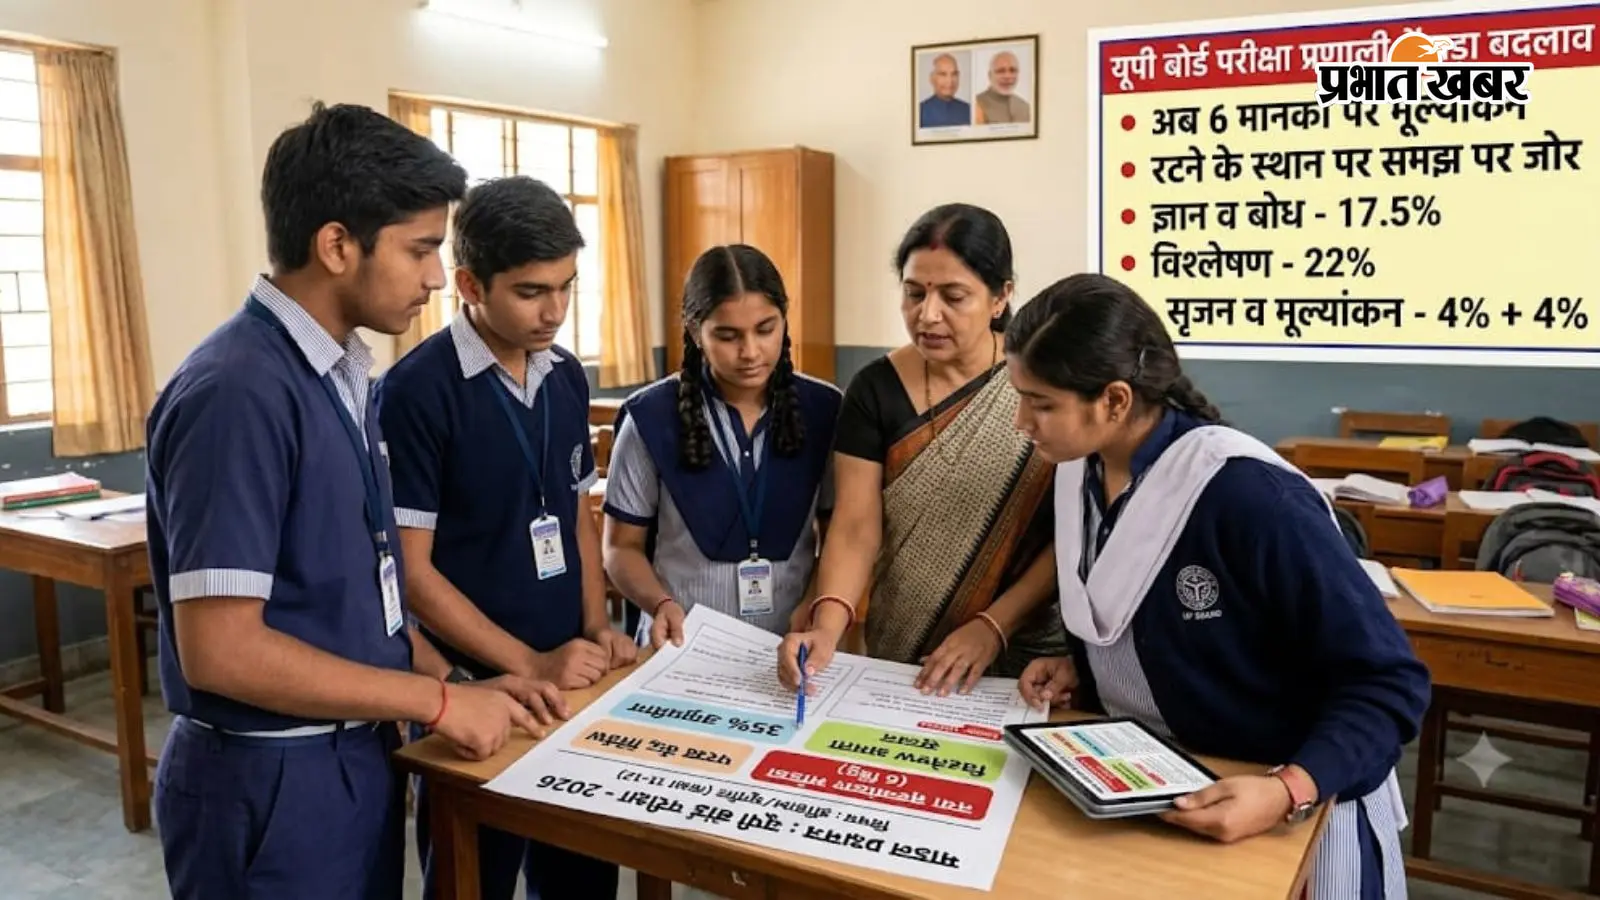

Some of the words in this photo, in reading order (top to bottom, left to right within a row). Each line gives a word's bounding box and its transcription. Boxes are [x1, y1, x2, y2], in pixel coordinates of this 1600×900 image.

[1110, 41, 1157, 89] यूपी
[1164, 39, 1209, 79] बोर्ड
[1216, 38, 1294, 75] परीक्षा
[1300, 29, 1391, 69] प्रणाली
[1488, 23, 1595, 58] बदलाव
[1151, 104, 1199, 136] अब
[1209, 105, 1227, 134] 6
[1151, 146, 1203, 184] रटने
[1212, 145, 1243, 181] के
[1251, 150, 1322, 180] स्थान
[1333, 147, 1371, 177] पर
[1381, 145, 1464, 178] समझ
[1471, 143, 1514, 173] पर
[1521, 130, 1583, 171] जोर
[1151, 203, 1208, 231] ज्ञान
[1215, 203, 1238, 230] व
[1245, 191, 1305, 229] बोध
[1339, 195, 1442, 228] 17.5%
[1150, 241, 1273, 279] विश्लेषण
[1304, 247, 1376, 279] 22%
[1166, 297, 1236, 337] सृजन
[1243, 297, 1267, 326] व
[1275, 289, 1404, 337] मूल्यांकन
[1437, 297, 1490, 329] 4%
[1501, 304, 1522, 326] +
[1533, 297, 1589, 331] 4%
[728, 715, 784, 737] 35%
[536, 775, 603, 798] 2026
